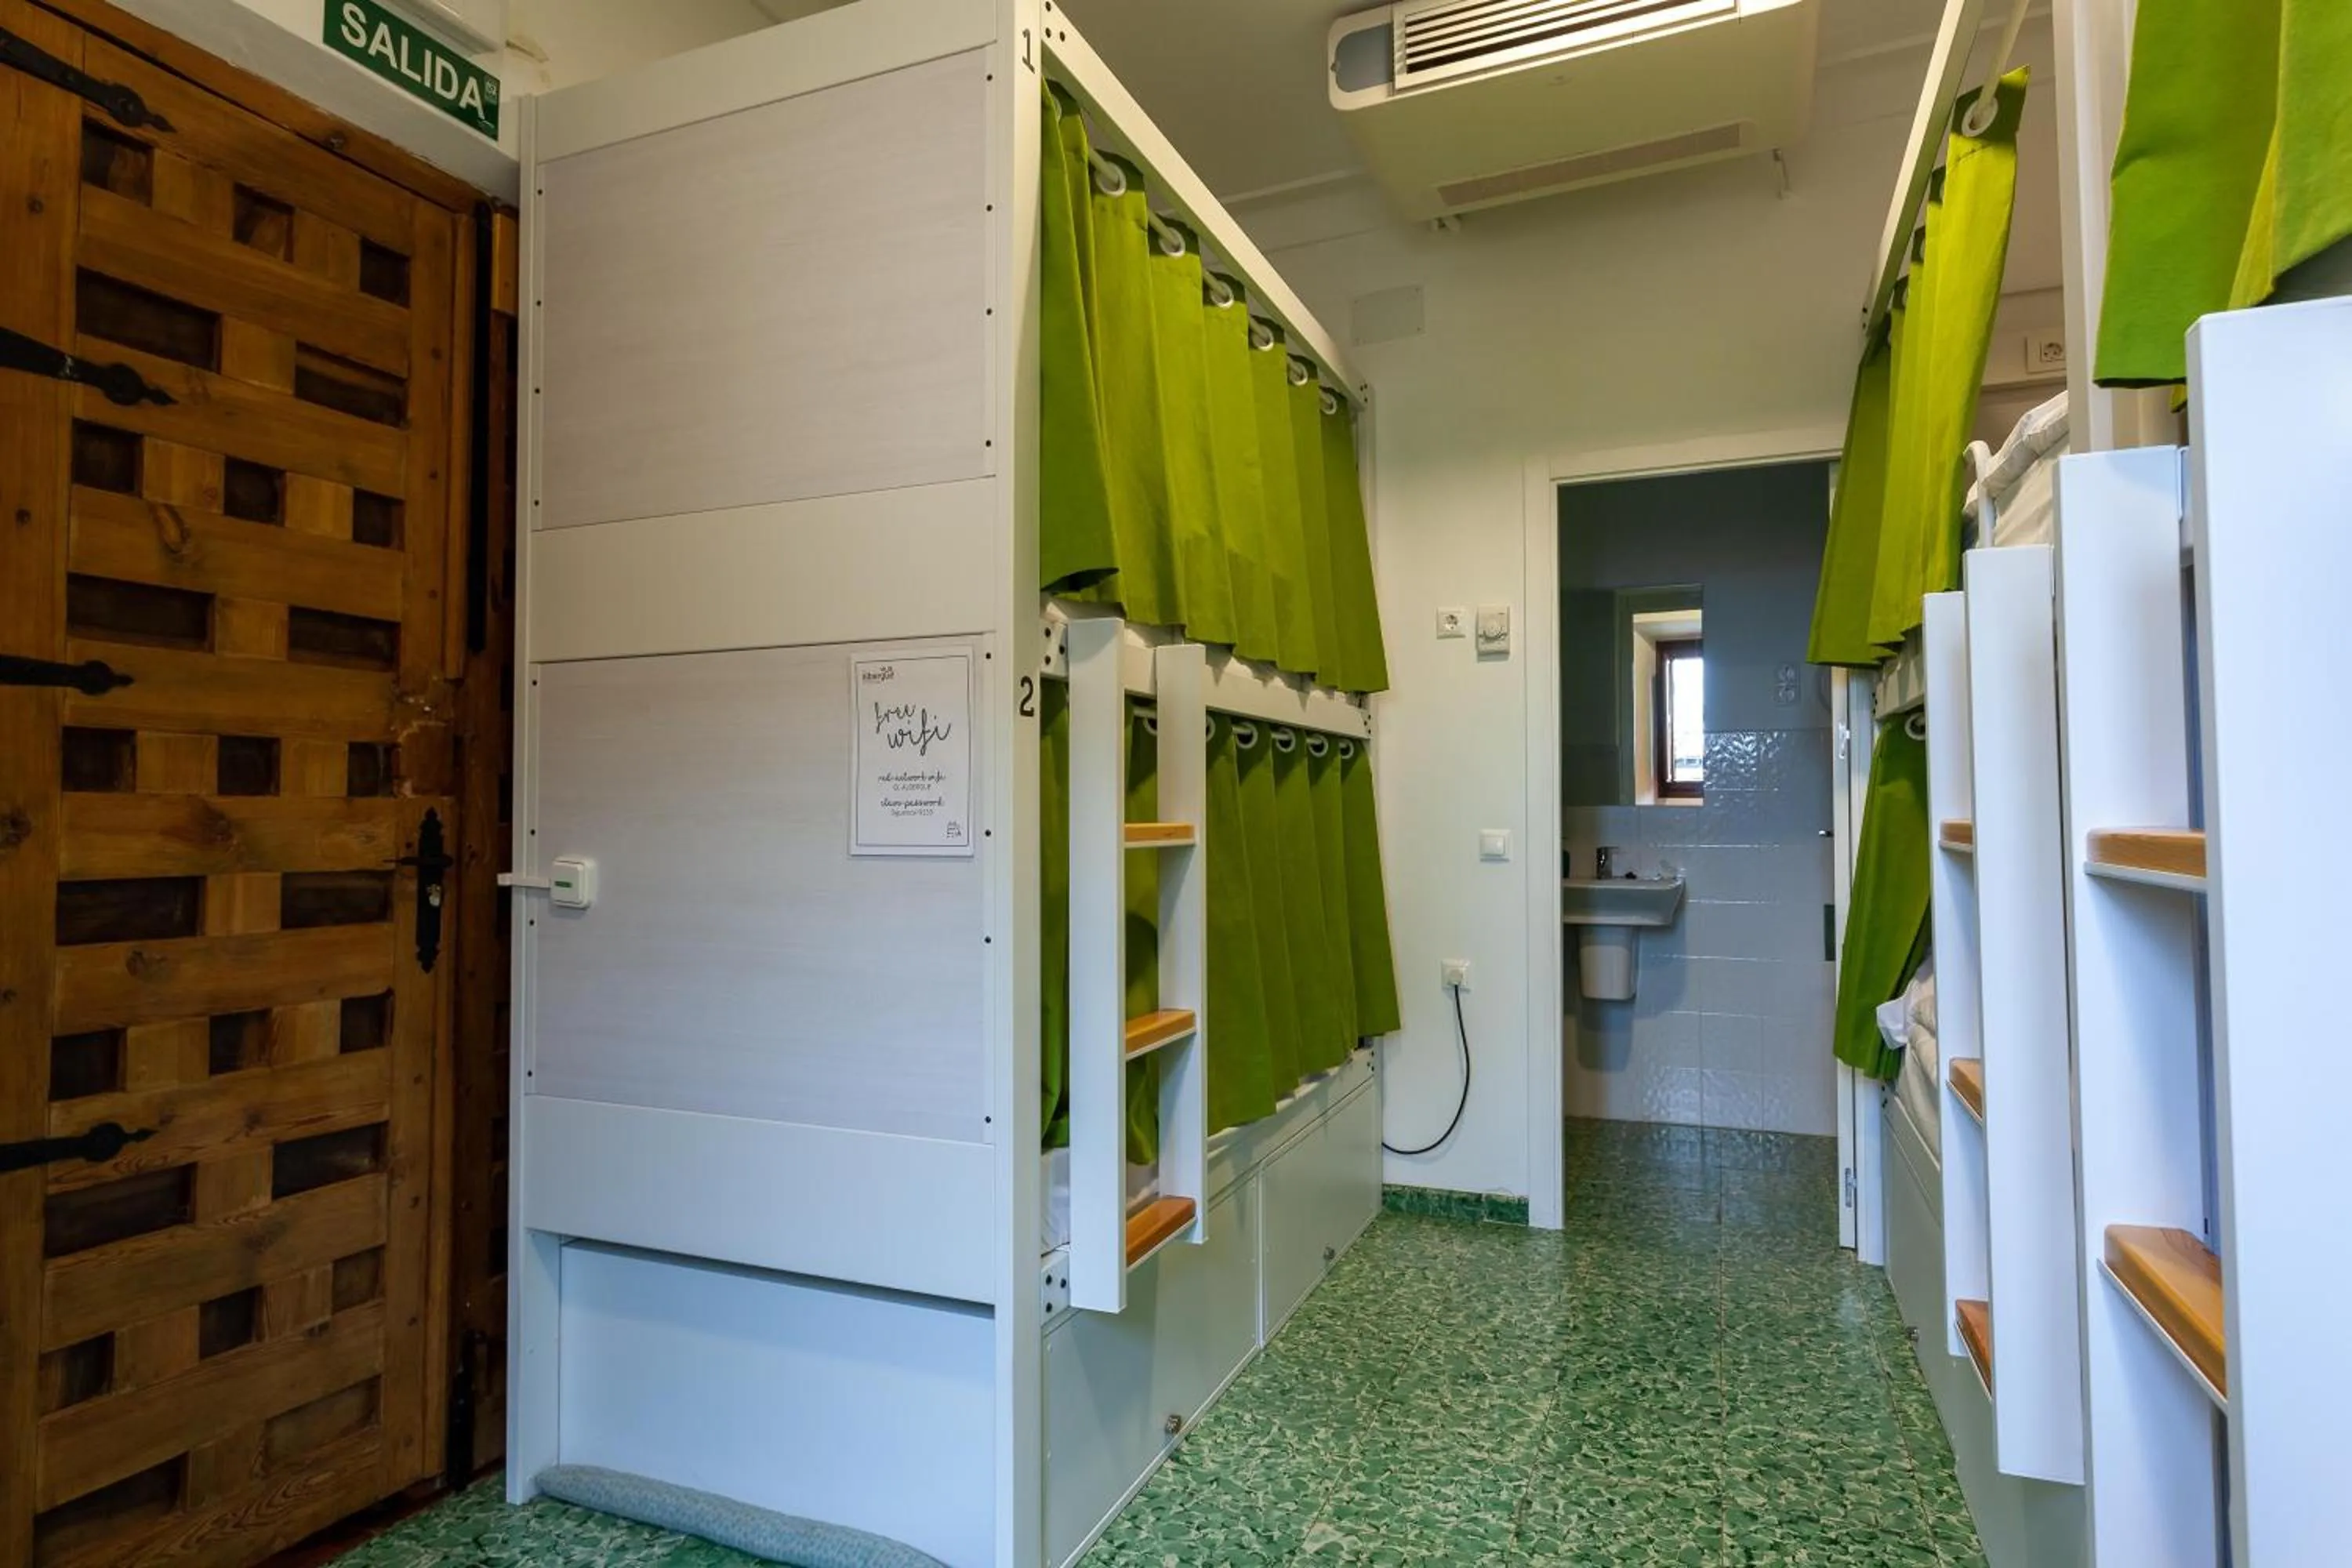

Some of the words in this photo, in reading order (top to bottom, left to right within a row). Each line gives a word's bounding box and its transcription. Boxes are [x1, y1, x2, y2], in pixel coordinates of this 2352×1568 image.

[341, 2, 485, 120] SALIDA
[1022, 28, 1035, 74] 1
[1020, 676, 1034, 717] 2
[887, 708, 951, 756] wifi
